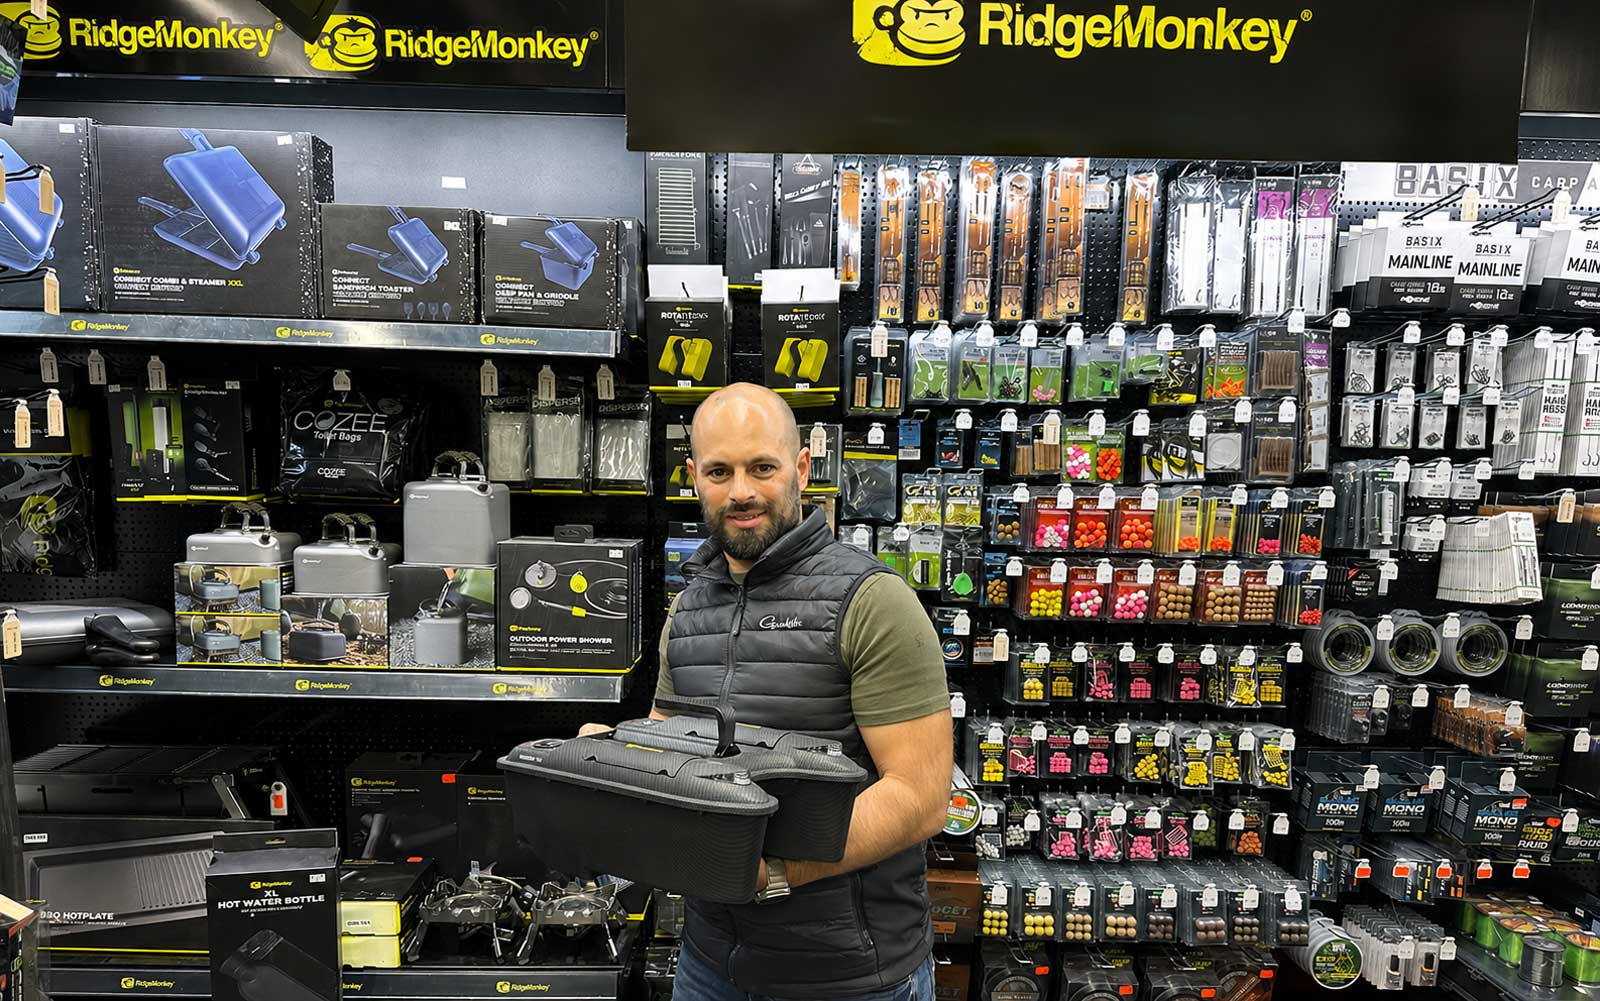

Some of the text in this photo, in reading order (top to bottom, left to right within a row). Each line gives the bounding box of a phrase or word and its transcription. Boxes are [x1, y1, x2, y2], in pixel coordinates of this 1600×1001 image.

[1396, 164, 1518, 199] BASIX
[1531, 176, 1579, 190] CARP
[1405, 236, 1443, 247] BASIX
[1475, 243, 1512, 255] BASIX
[1387, 255, 1454, 269] MAINLINE
[1457, 261, 1523, 277] MAINLINE
[113, 275, 152, 284] CONNECT
[188, 278, 227, 287] STEAMER
[332, 276, 370, 284] CONNECT
[379, 286, 415, 294] TOASTER
[495, 282, 535, 291] CONNECT
[293, 410, 389, 433] COZEE
[338, 432, 362, 443] Bags
[509, 635, 613, 645] OUTDOOR POWER SHOWER
[1317, 802, 1359, 812] MONO
[1382, 804, 1425, 814] MONO
[1475, 815, 1519, 826] MONO
[264, 889, 280, 898] XL
[217, 894, 326, 909] HOT WATER BOTTLE
[62, 910, 115, 921] HOTPLATE
